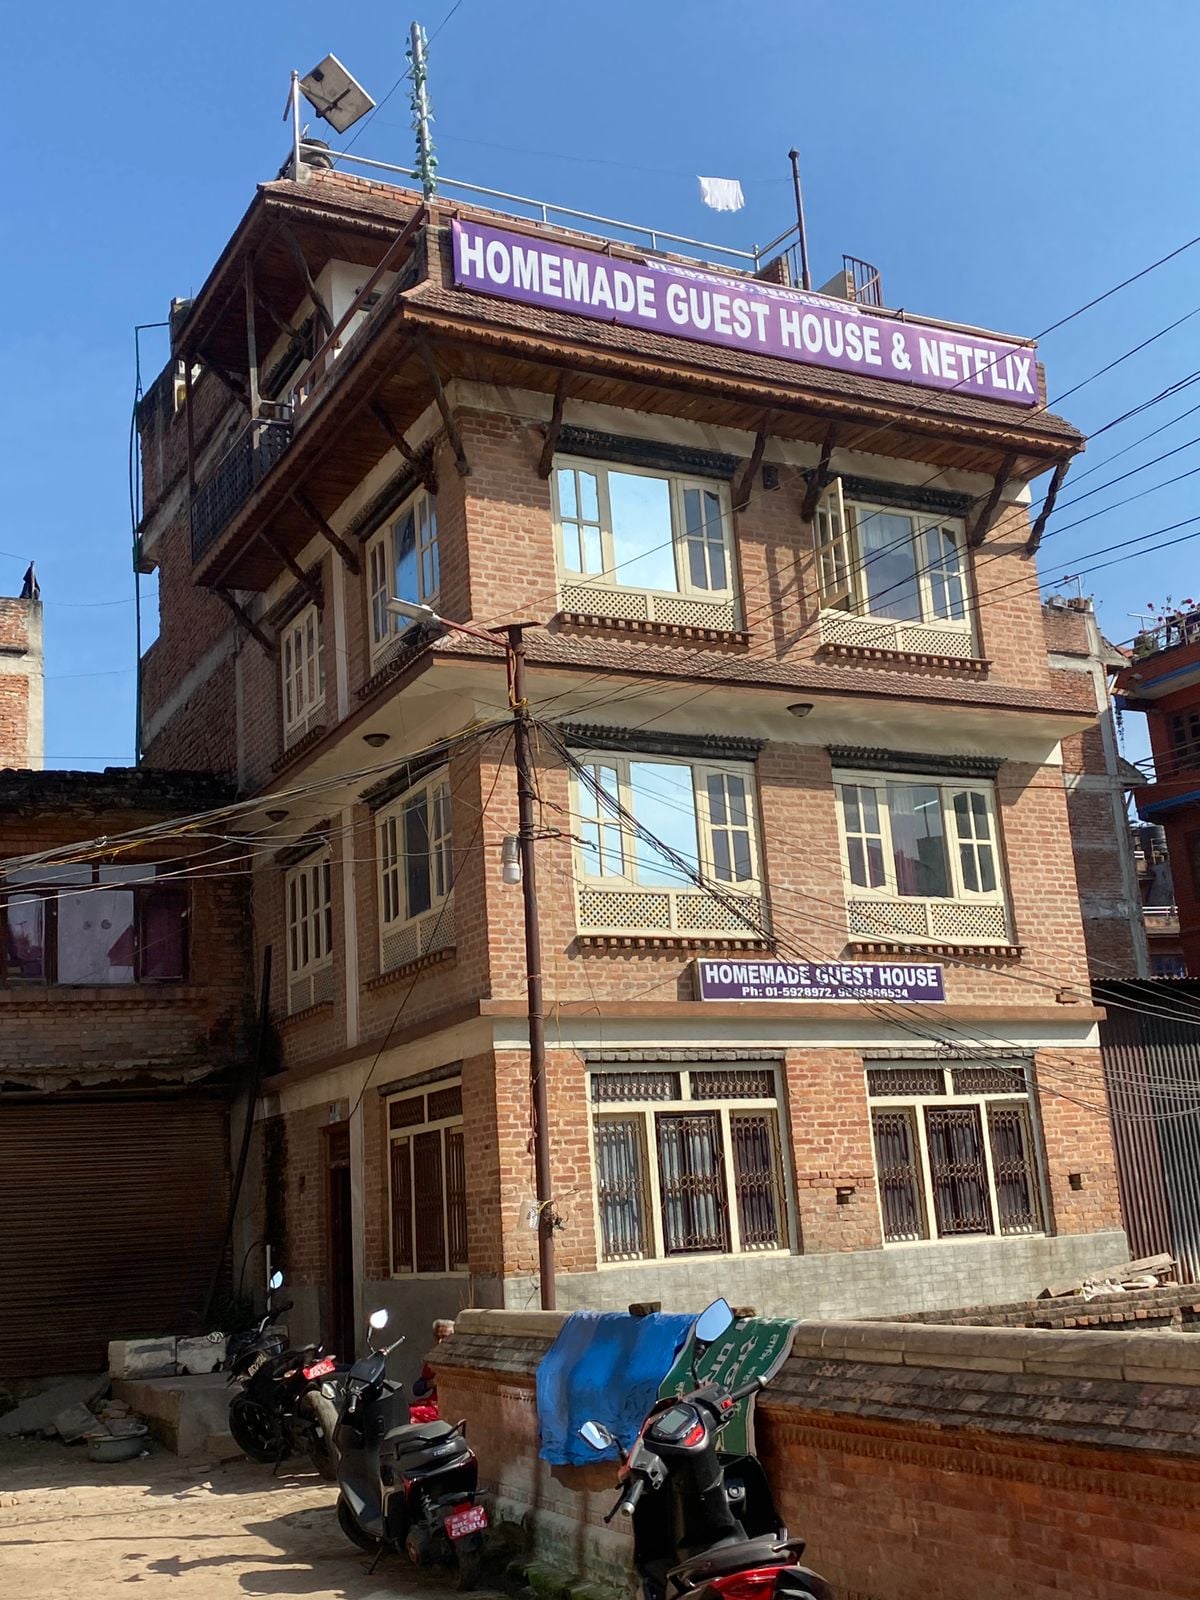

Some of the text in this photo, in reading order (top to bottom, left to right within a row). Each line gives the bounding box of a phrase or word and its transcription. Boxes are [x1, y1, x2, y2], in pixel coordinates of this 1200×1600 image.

[460, 232, 1034, 394] HOMEMADE GUEST HOUSE & NETFLIX
[705, 964, 938, 987] HOMEMADE GUEST HOUSE
[742, 986, 763, 997] Ph:
[765, 987, 836, 998] 01-5928972,
